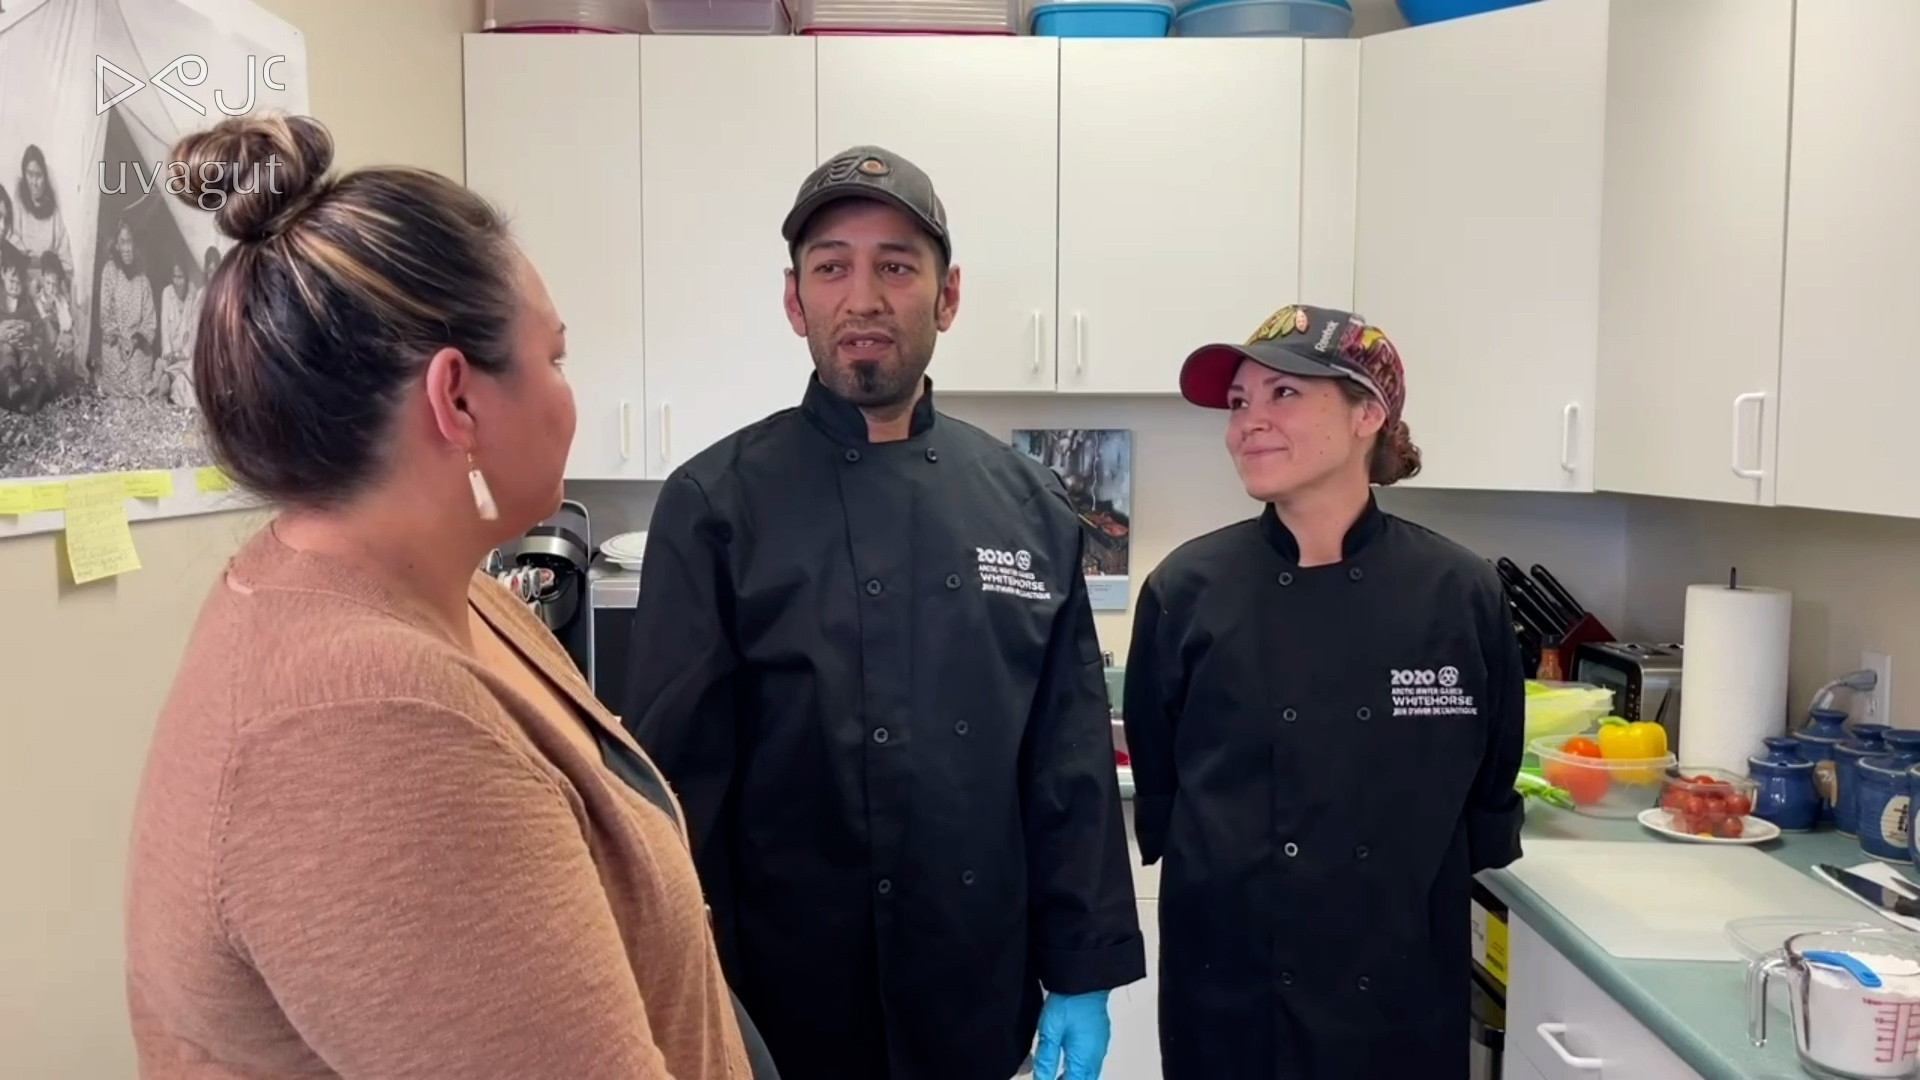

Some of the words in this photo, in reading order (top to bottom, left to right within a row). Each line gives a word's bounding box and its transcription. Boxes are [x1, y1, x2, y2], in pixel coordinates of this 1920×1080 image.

[1314, 320, 1340, 352] Reebok
[976, 547, 1015, 566] 2020
[980, 572, 1046, 592] WHITEHORSE
[1390, 669, 1436, 686] 2020
[1392, 695, 1474, 706] WHITEHORSE
